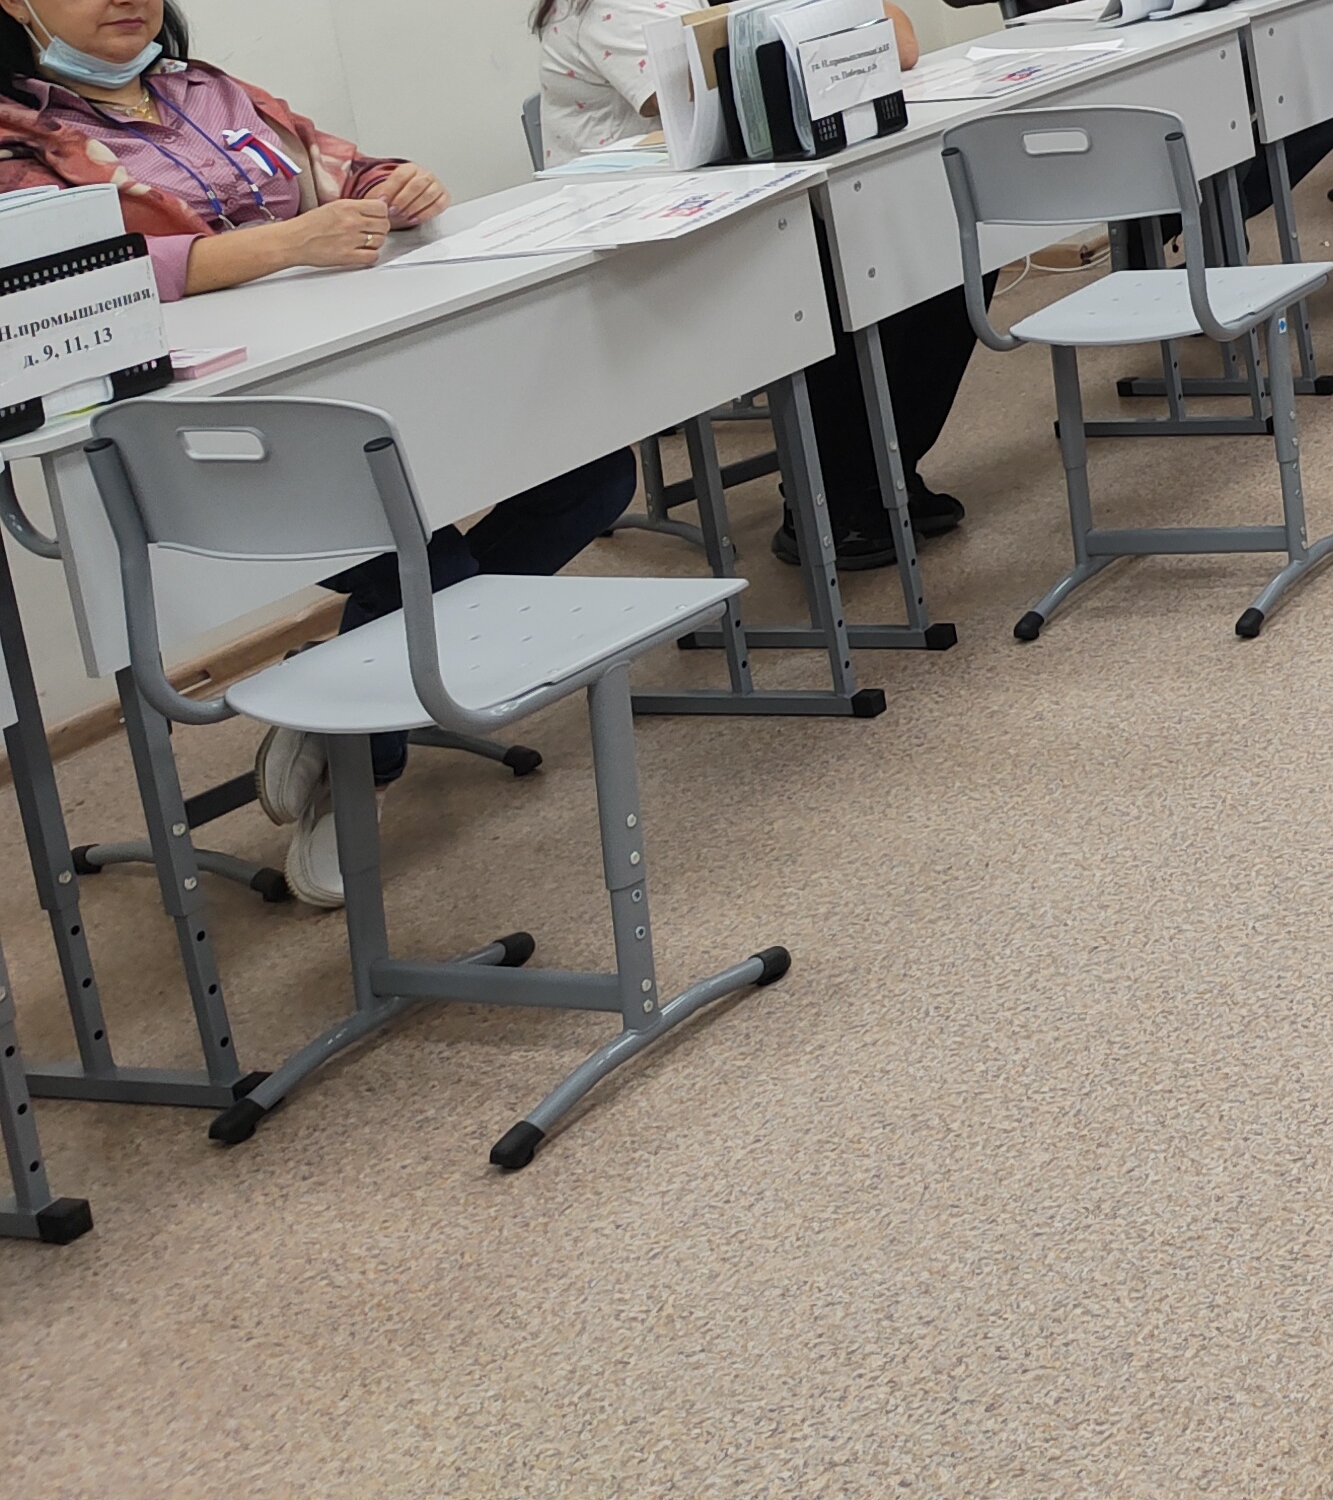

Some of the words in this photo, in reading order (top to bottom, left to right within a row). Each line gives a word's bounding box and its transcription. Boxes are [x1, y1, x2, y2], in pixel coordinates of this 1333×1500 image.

[23, 354, 39, 369] д.
[43, 344, 60, 361] 9,
[64, 335, 89, 355] 11,
[94, 327, 113, 345] 13
